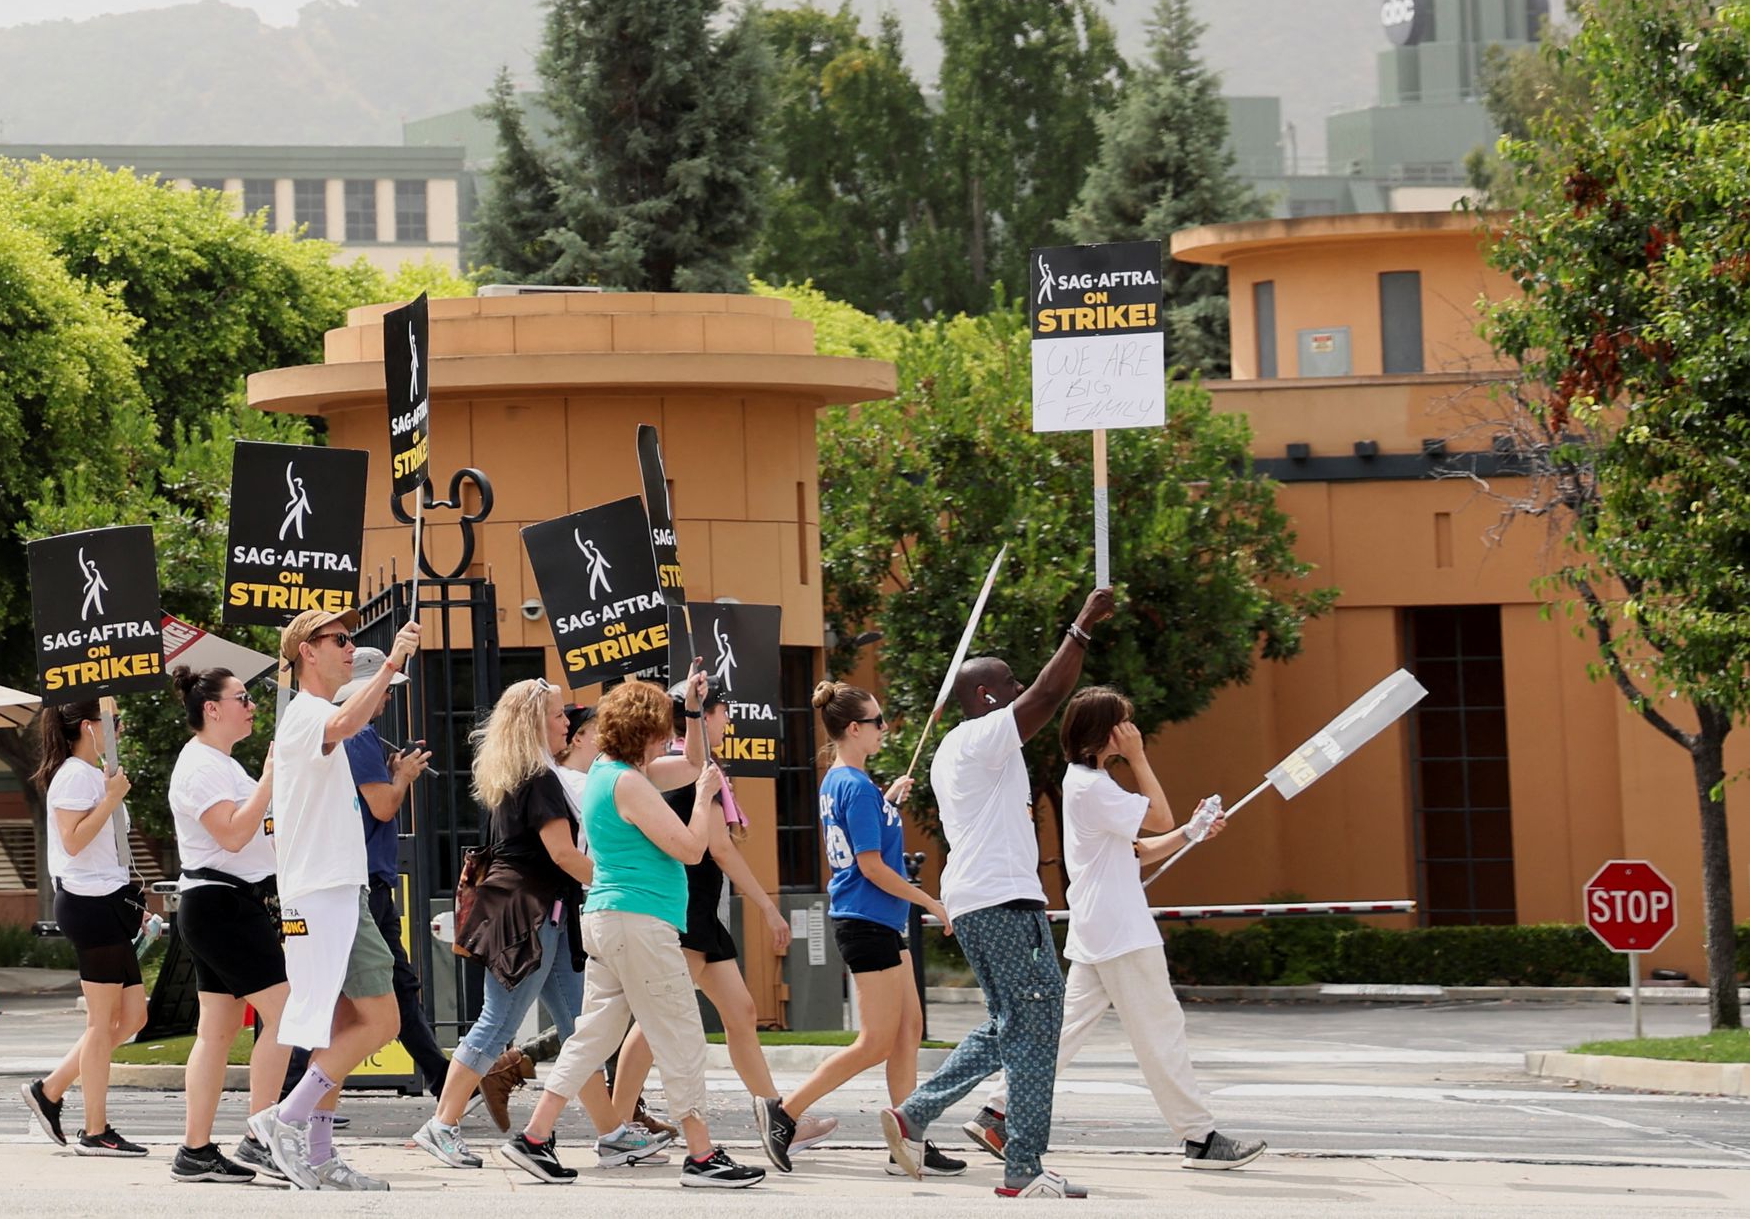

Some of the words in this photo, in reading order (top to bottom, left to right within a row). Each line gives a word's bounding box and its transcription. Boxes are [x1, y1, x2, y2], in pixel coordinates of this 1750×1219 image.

[1083, 292, 1108, 304] ON
[1037, 303, 1157, 333] STRIKE!
[1046, 345, 1091, 376] WE
[1102, 341, 1152, 377] ARE
[1065, 378, 1111, 398] BIG
[1064, 399, 1155, 424] FAMILY
[278, 571, 304, 585] ON
[229, 582, 353, 613] STRIKE!
[603, 621, 627, 637] ON
[87, 645, 111, 659] ON
[45, 653, 160, 690] STRIKE!
[1591, 890, 1669, 923] STOP
